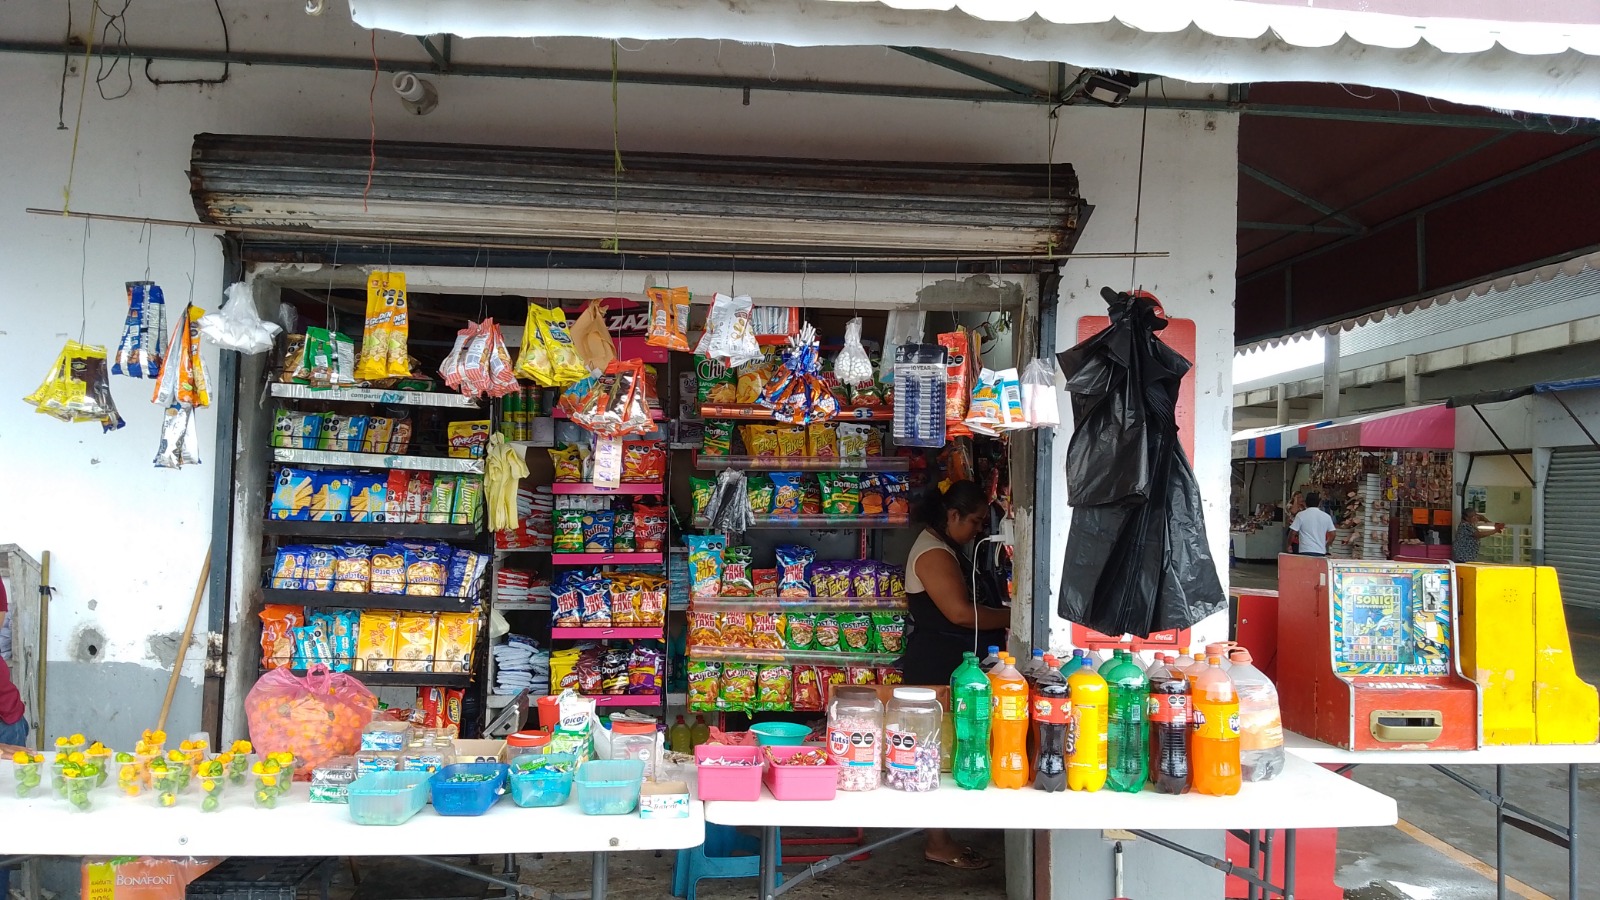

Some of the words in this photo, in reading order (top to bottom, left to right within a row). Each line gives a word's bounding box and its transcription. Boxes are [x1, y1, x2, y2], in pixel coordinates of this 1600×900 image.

[350, 391, 382, 400] compartir
[704, 427, 729, 437] Doritos
[757, 437, 778, 452] Takis
[781, 436, 804, 456] Takis
[833, 480, 859, 489] Doritos
[583, 523, 611, 540] Ruffles
[697, 557, 716, 569] BIG
[724, 563, 744, 572] PAKE
[695, 566, 716, 583] MIX
[724, 571, 745, 581] TAXO
[828, 576, 850, 597] Takis
[854, 576, 876, 596] Takis
[557, 590, 578, 604] PAKE
[584, 592, 604, 606] PAKE
[641, 591, 662, 602] PAKE
[1356, 595, 1392, 605] SONIC
[559, 600, 580, 613] TAXO
[586, 601, 606, 615] TAXO
[612, 601, 633, 613] TAXO
[694, 612, 714, 621] PAKE
[726, 617, 745, 626] TAXO
[755, 615, 775, 625] PAKE
[695, 619, 715, 628] TAXO
[755, 623, 775, 632] TAXO
[602, 664, 626, 675] Doritos
[1405, 664, 1424, 673] ANGRY
[1427, 664, 1446, 673] BIRDS
[1193, 709, 1206, 724] NTA
[830, 732, 849, 744] Tutsi
[116, 873, 175, 887] BONAFONT
